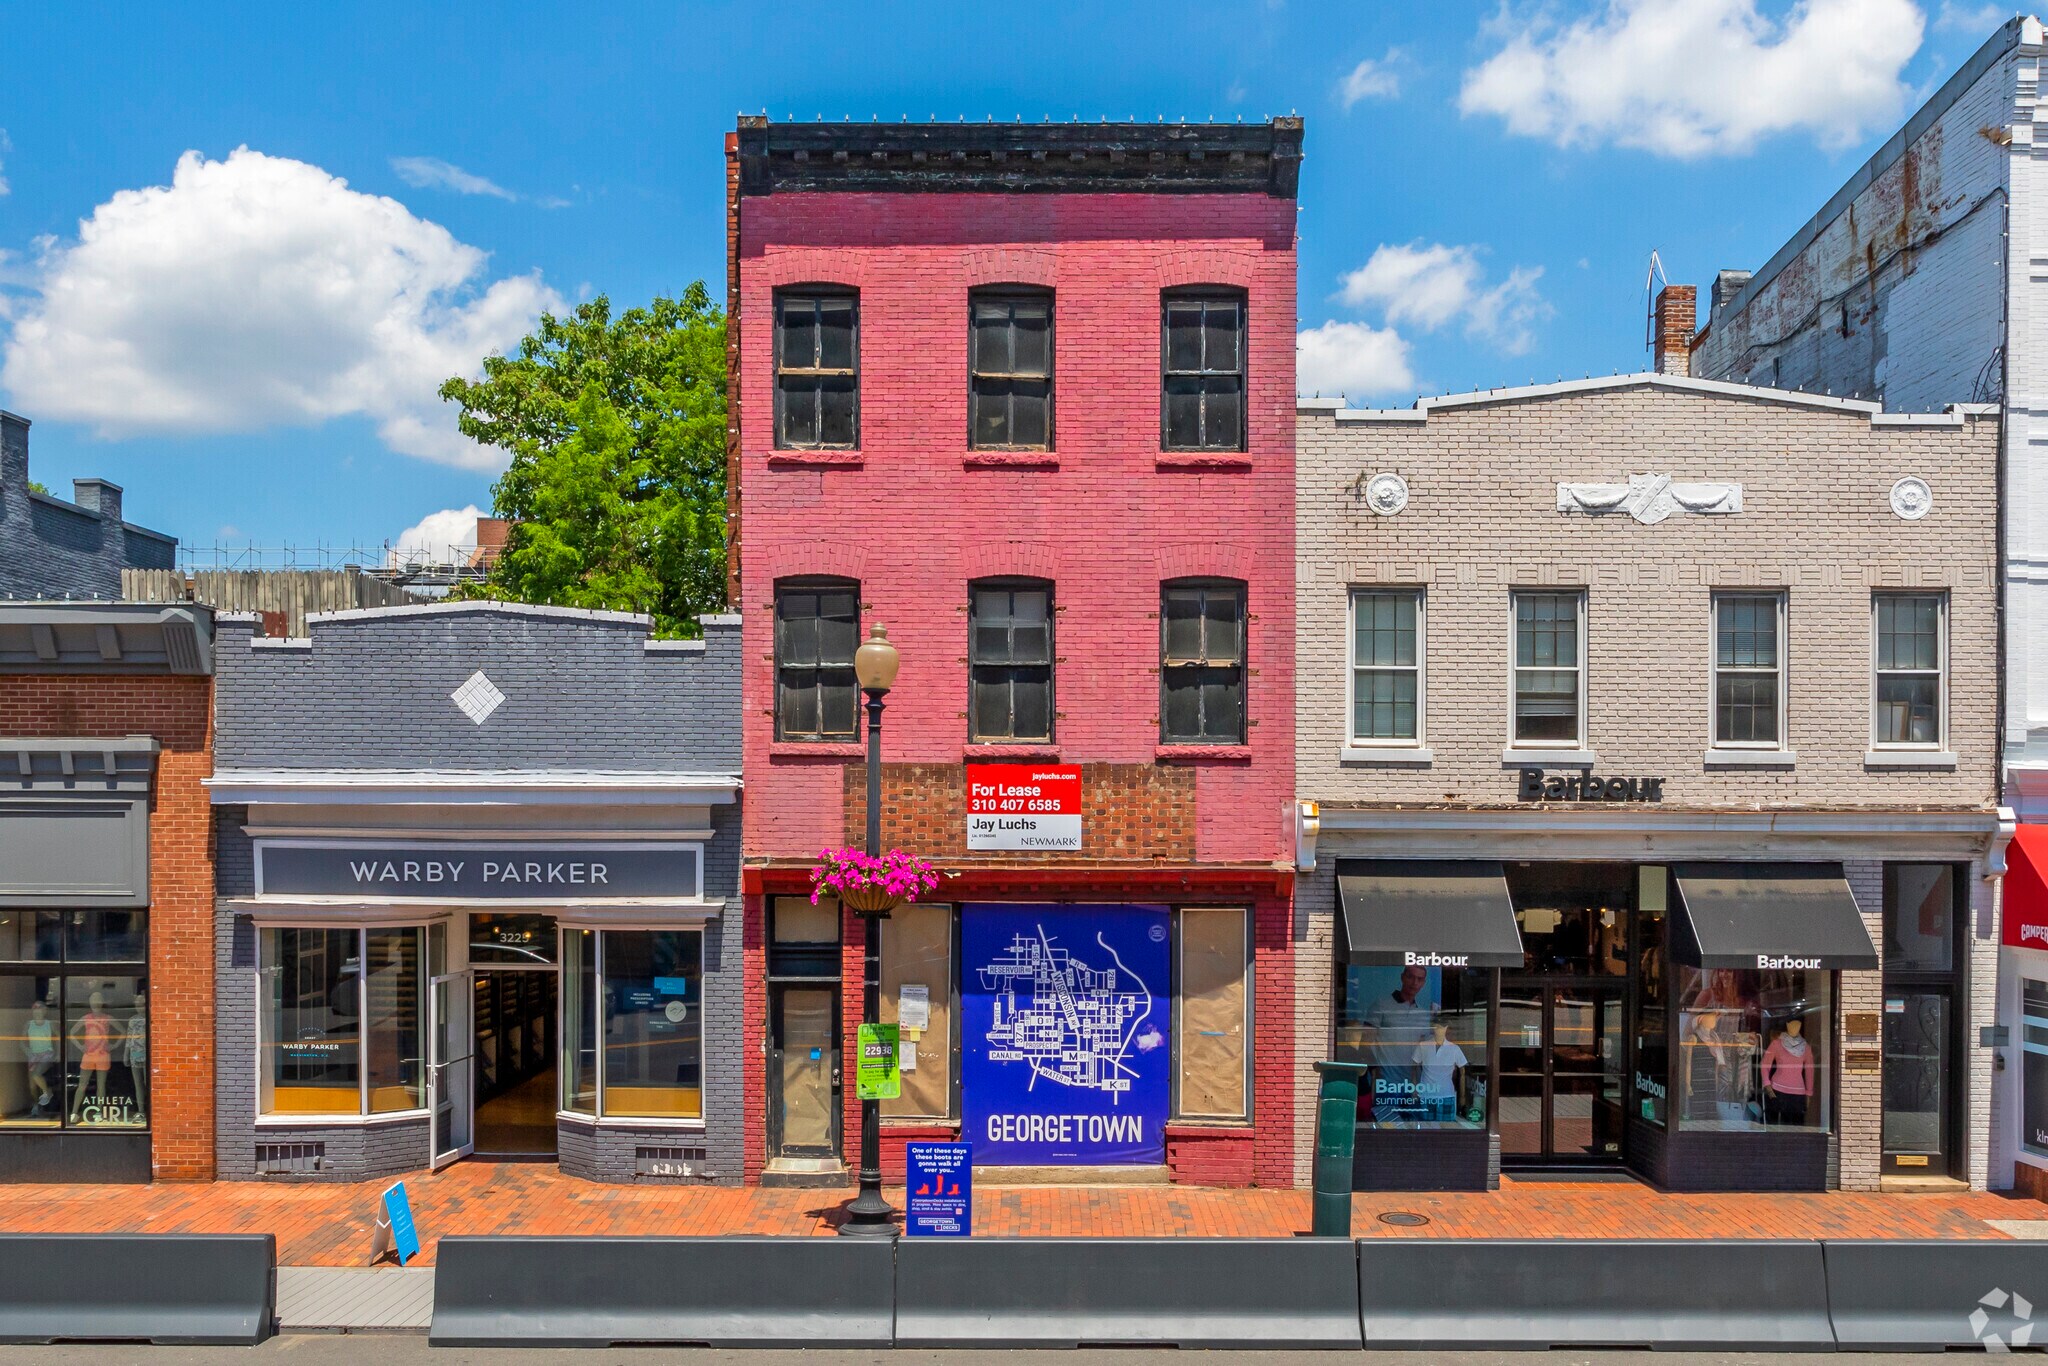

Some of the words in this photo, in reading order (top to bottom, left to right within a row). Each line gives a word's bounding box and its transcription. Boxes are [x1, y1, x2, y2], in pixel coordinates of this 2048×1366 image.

[1032, 773, 1077, 781] jayluchs.com
[972, 784, 995, 796] For
[998, 784, 1041, 796] Lease
[1518, 768, 1666, 802] Barbour
[972, 799, 996, 811] 310
[1000, 799, 1024, 811] 407
[1028, 799, 1061, 811] 6585
[972, 819, 995, 832] Jay
[998, 819, 1037, 830] Luchs
[1021, 837, 1077, 846] NEWMARK
[350, 861, 465, 882] WARBY
[483, 862, 609, 884] PARKER
[989, 966, 1025, 974] RESERVOIR
[1053, 973, 1076, 1019] WISCONSIN
[1016, 1032, 1023, 1043] 37
[865, 1046, 893, 1056] 22938
[1069, 1052, 1078, 1060] M
[1042, 1067, 1064, 1082] WATER
[1109, 1081, 1118, 1089] K
[82, 1096, 133, 1105] ATHLETA
[1375, 1097, 1417, 1105] summer
[1420, 1095, 1444, 1106] shop
[82, 1105, 130, 1125] GIRL
[987, 1114, 1143, 1143] GEORGETOWN
[952, 1147, 967, 1155] days
